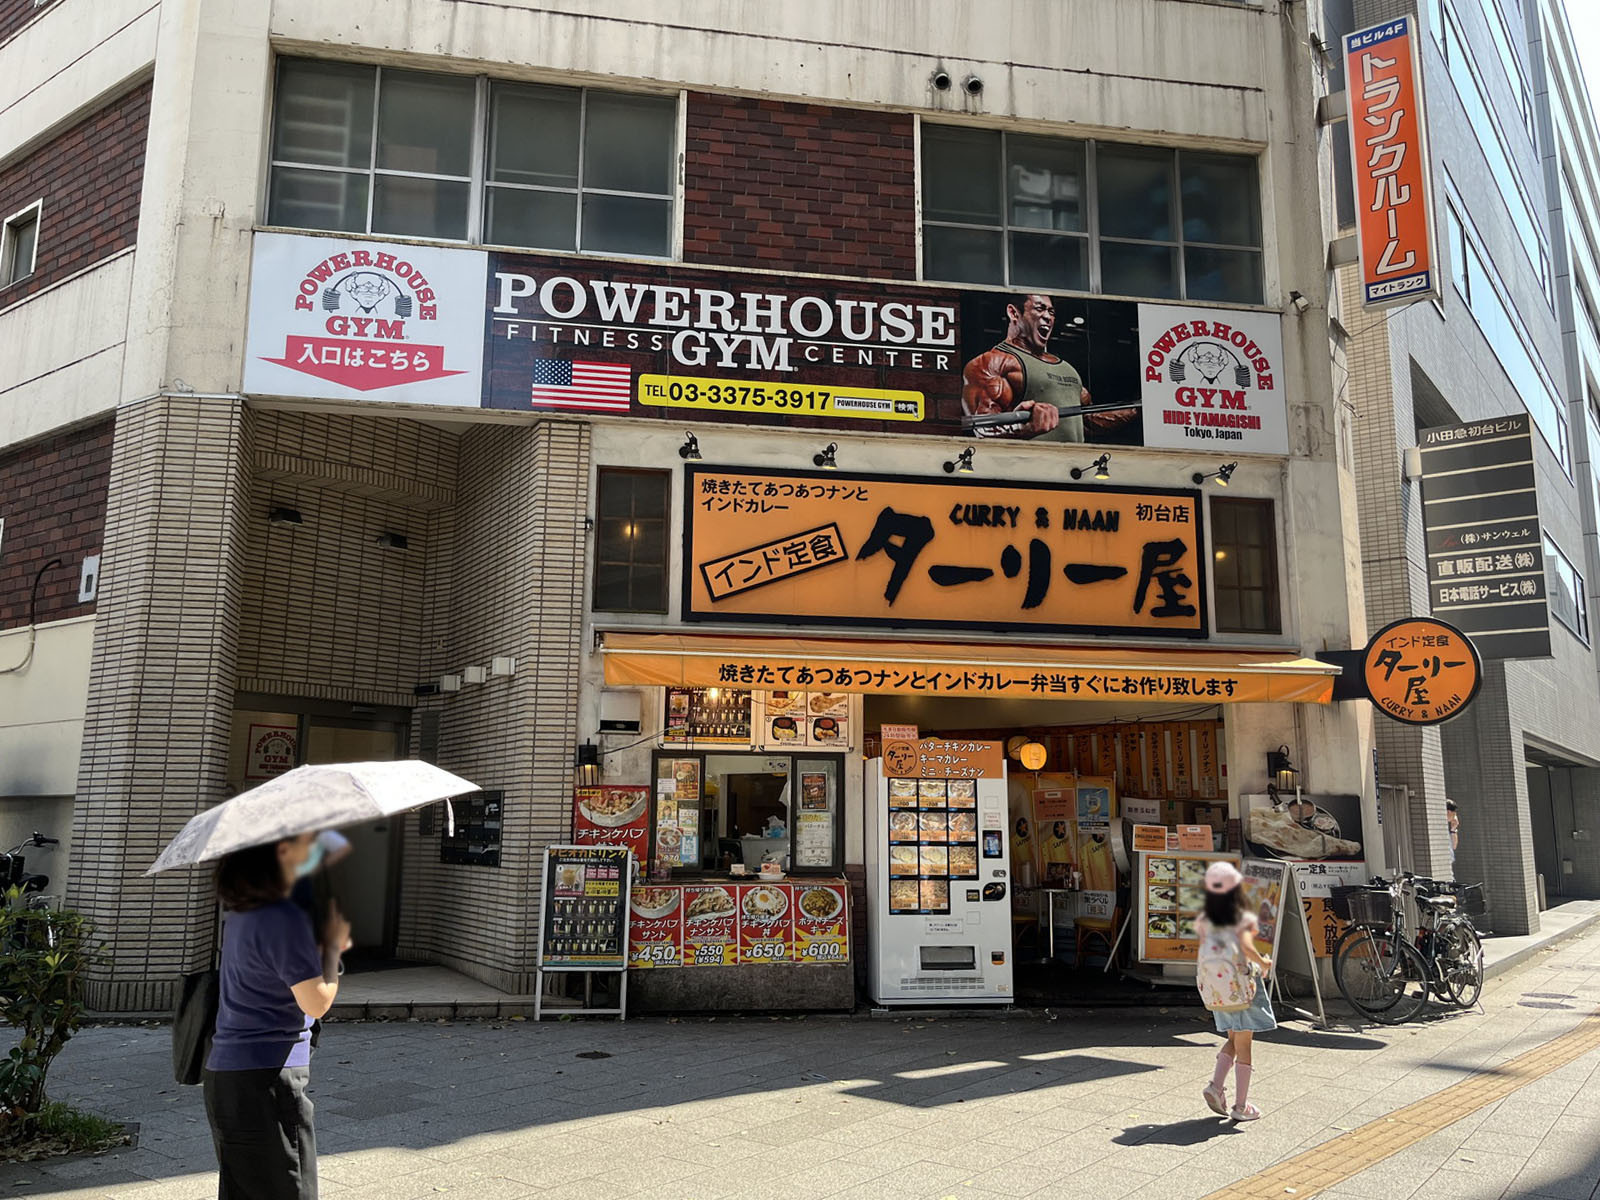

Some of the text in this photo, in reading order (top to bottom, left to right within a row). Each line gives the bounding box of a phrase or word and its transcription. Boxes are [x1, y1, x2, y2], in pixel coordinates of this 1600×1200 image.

[1350, 23, 1403, 48] 当ビル4F
[1362, 52, 1416, 275] トランクルーム
[295, 250, 437, 321] POWERHOUSE
[1371, 277, 1424, 296] マイトランク
[493, 272, 956, 346] POWERHOUSE
[325, 315, 405, 339] GYM
[297, 343, 431, 372] 入口はこちら
[507, 324, 949, 372] FITNESS GYM CENTER
[1146, 320, 1274, 390] POWERHOUSE
[645, 382, 830, 411] TEL 03-3375-3917
[837, 399, 891, 410] POWERHOUSE GYM
[1175, 387, 1248, 411] GYM
[1163, 410, 1261, 430] HIDE YAMAGISHI
[1426, 420, 1522, 443] 小田急初台ビル
[1184, 427, 1243, 441] Tokyo, Japan
[701, 478, 869, 501] 焼きたてあつあつナンと
[702, 496, 789, 513] インドカレー
[1136, 503, 1190, 523] 初台店
[949, 503, 1120, 533] CURRY & NAAN
[1460, 528, 1531, 544] (株)サンウェル
[714, 534, 838, 588] インド定食
[855, 505, 1197, 618] ターリー屋
[1386, 634, 1449, 649] インド定食
[1373, 648, 1466, 683] ターリー
[718, 663, 1239, 696] 焼きたてあつあつナンとインドカレー弁当すぐにお作り致します
[1403, 675, 1431, 705] 屋
[1381, 693, 1462, 719] CURRY & NAAN
[920, 742, 991, 751] バターチキンカレー
[920, 754, 968, 764] キーマカレー
[921, 767, 984, 777] ミニ・チーズナン
[578, 828, 646, 839] チキンケバブ
[686, 918, 736, 928] チキンケバブ
[810, 926, 834, 934] キーマ
[631, 945, 676, 963] ¥450
[696, 945, 724, 956] ¥550
[745, 943, 786, 958] ¥650
[802, 943, 841, 957] ¥600
